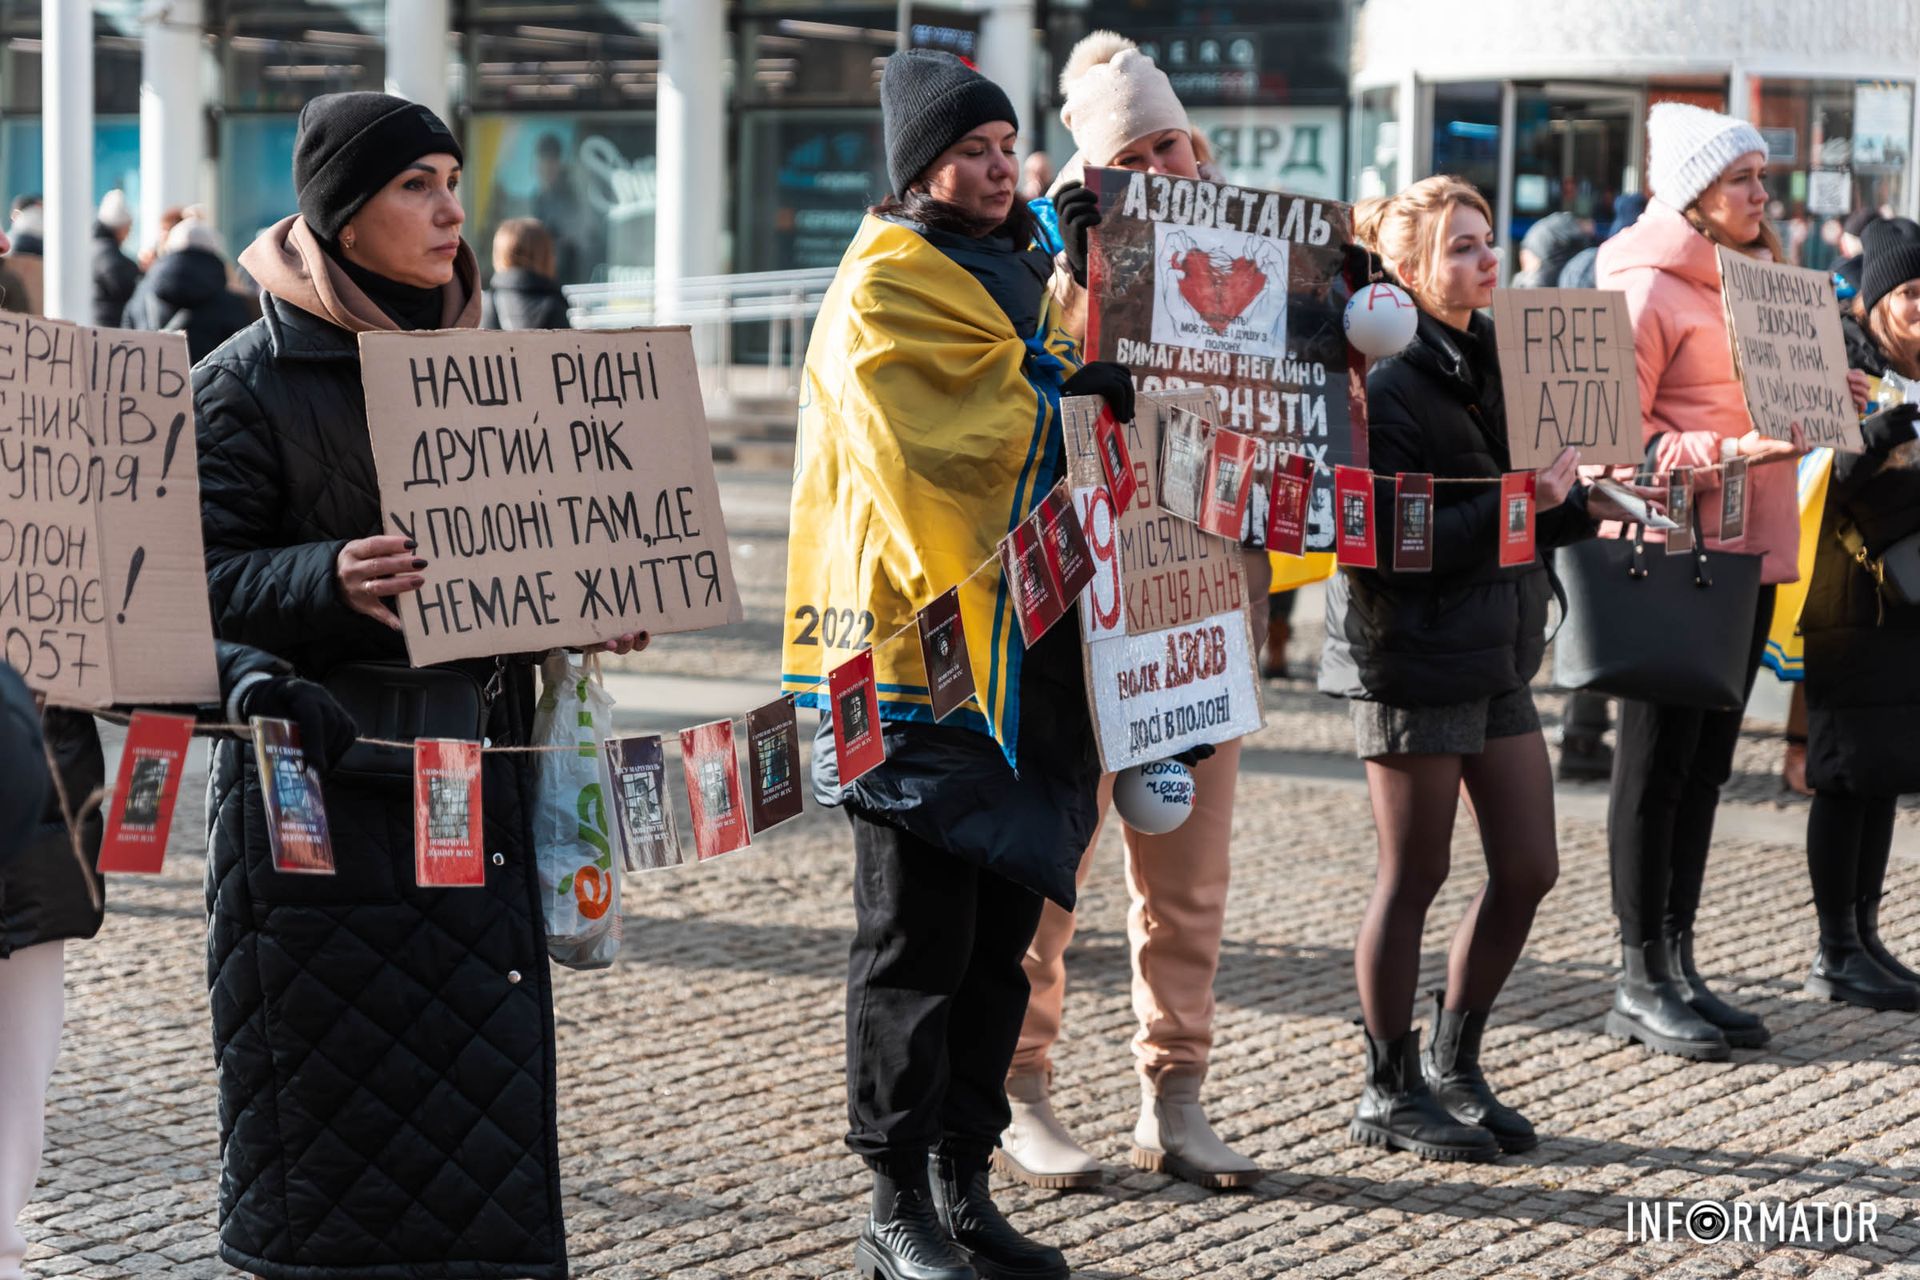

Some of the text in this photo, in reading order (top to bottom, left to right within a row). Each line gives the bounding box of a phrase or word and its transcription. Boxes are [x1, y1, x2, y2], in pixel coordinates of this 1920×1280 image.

[1122, 172, 1332, 247] АЗОВСТАЛЬ
[1236, 350, 1327, 387] НЕГАЙНО
[1524, 306, 1610, 374] FREE
[409, 342, 660, 410] НАШІ РІДНІ
[1534, 380, 1621, 450] AZOV
[403, 411, 634, 492] ДРУГИЙ РІК
[390, 511, 417, 556] У
[426, 490, 554, 559] ПОЛОНІ
[575, 550, 723, 620] ЖИТТЯ
[1125, 556, 1241, 633] КАТУВАНЬ
[793, 604, 875, 650] 2022
[1165, 624, 1227, 689] АЗОВ
